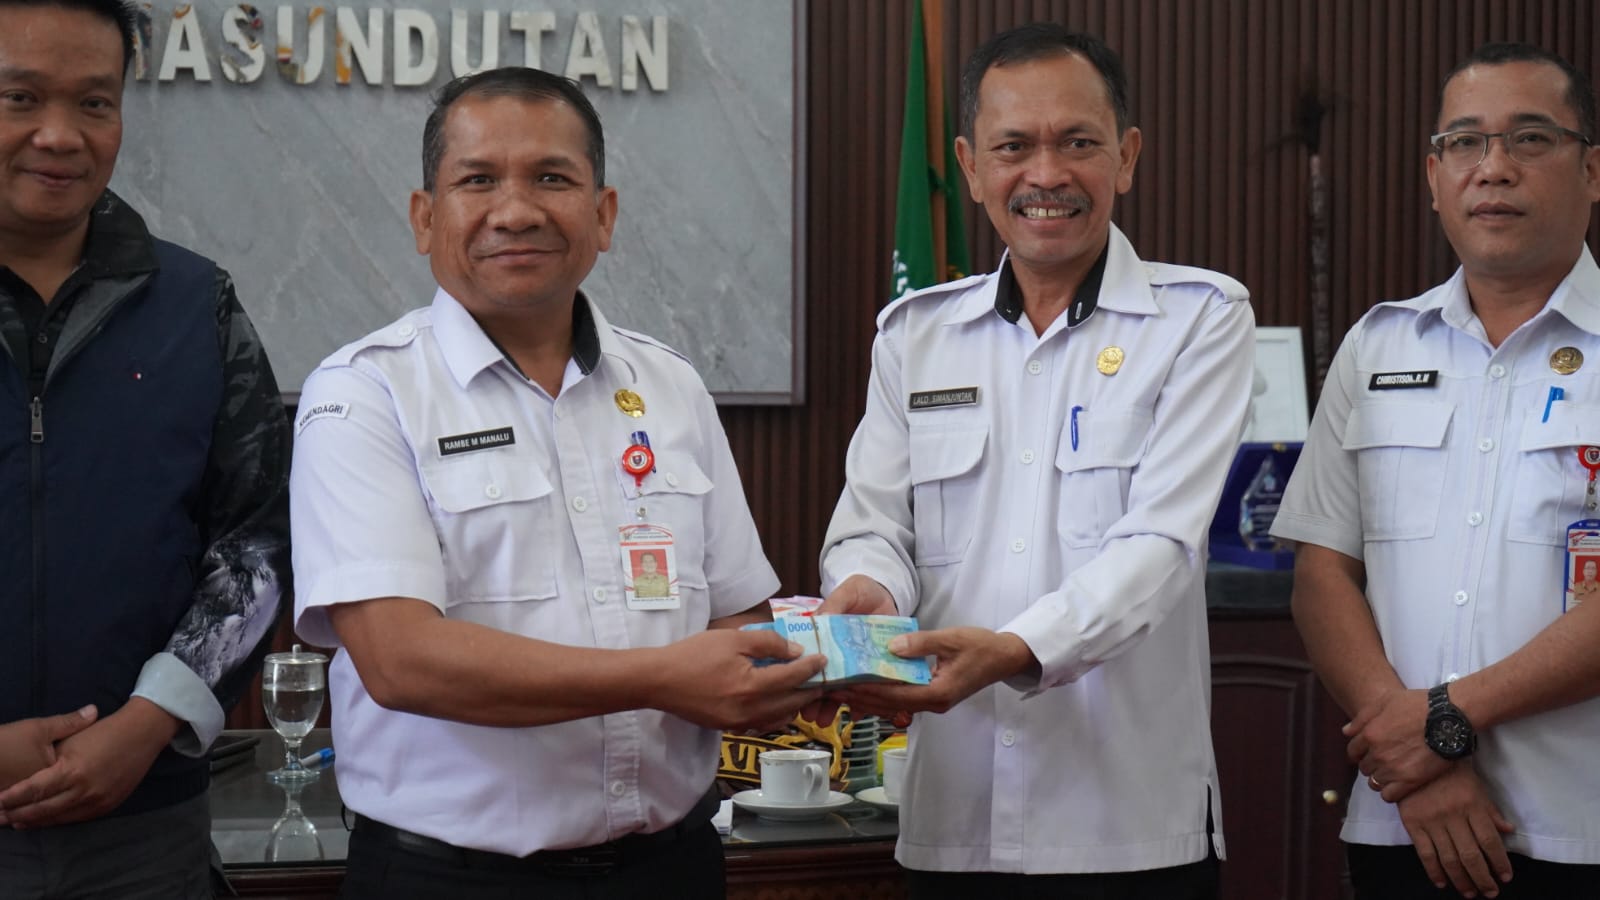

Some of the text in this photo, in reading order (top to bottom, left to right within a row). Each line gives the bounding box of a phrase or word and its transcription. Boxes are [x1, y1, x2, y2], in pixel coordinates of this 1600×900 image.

[444, 433, 509, 450] RAMBE M MANALU
